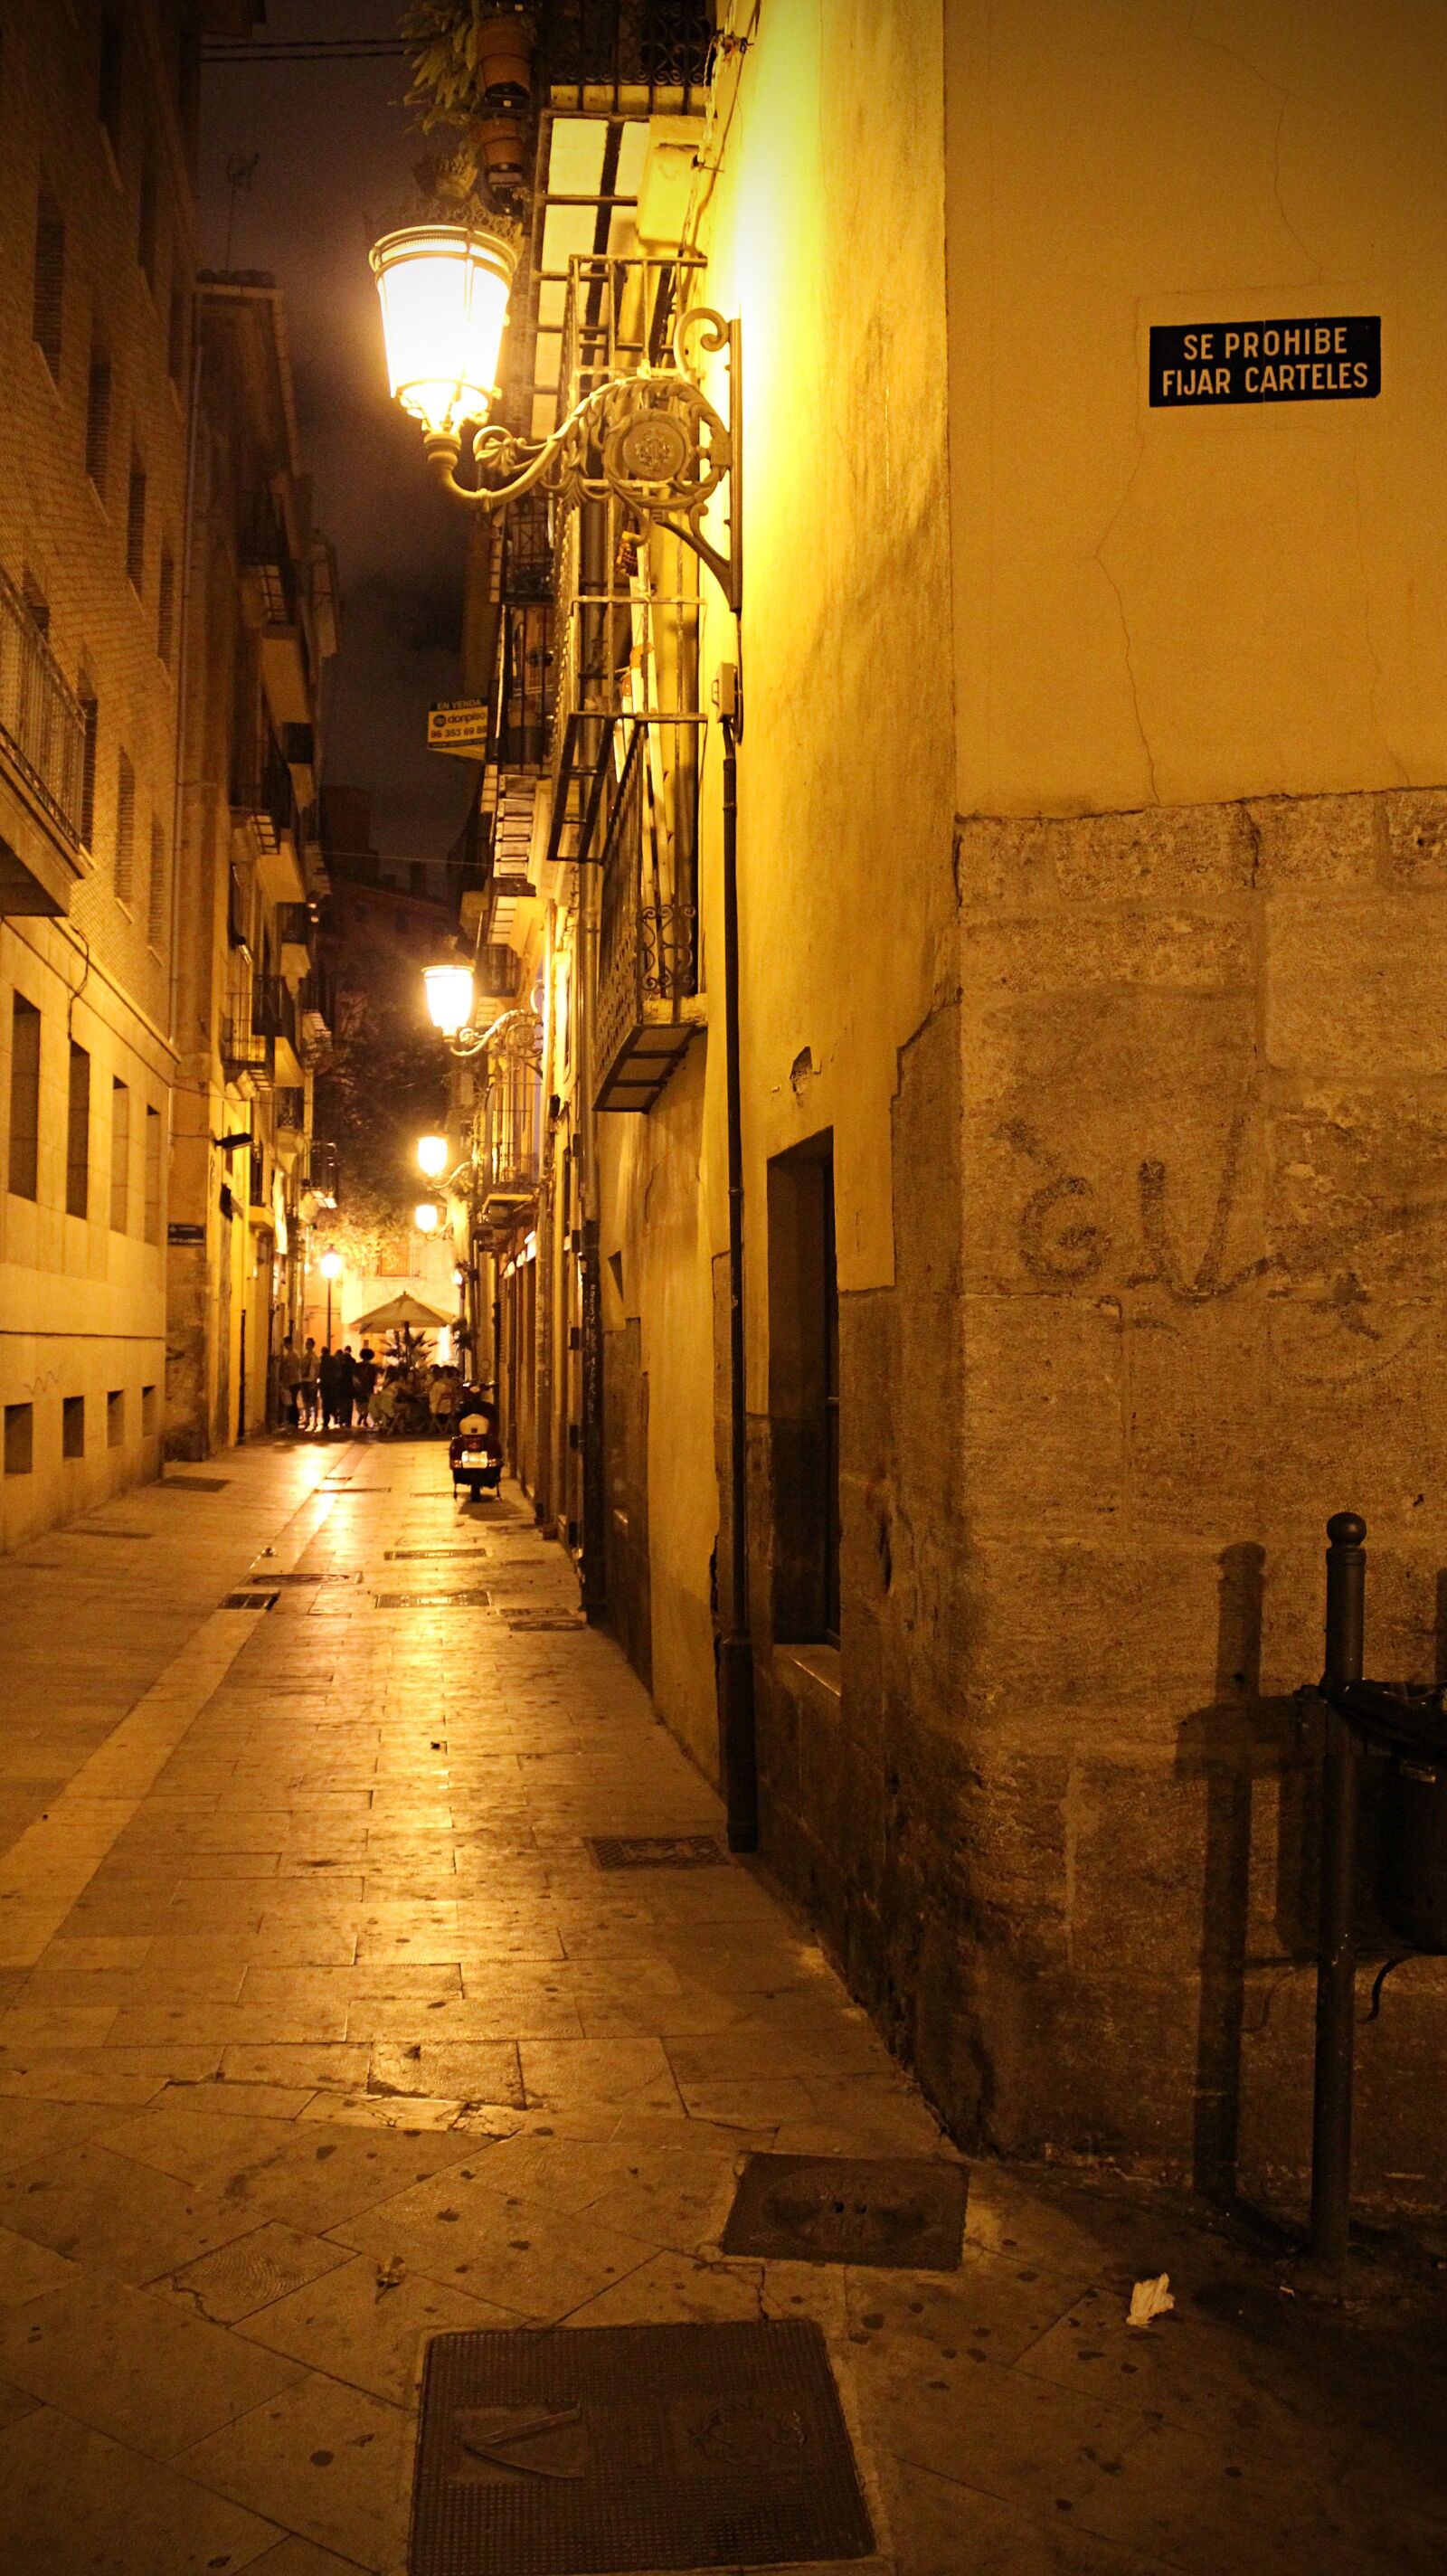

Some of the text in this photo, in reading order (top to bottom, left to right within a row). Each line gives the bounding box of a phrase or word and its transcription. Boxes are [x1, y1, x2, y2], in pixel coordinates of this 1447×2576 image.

[1183, 327, 1348, 361] SE PROHIBE
[1162, 362, 1368, 396] FIJAR CARTELES
